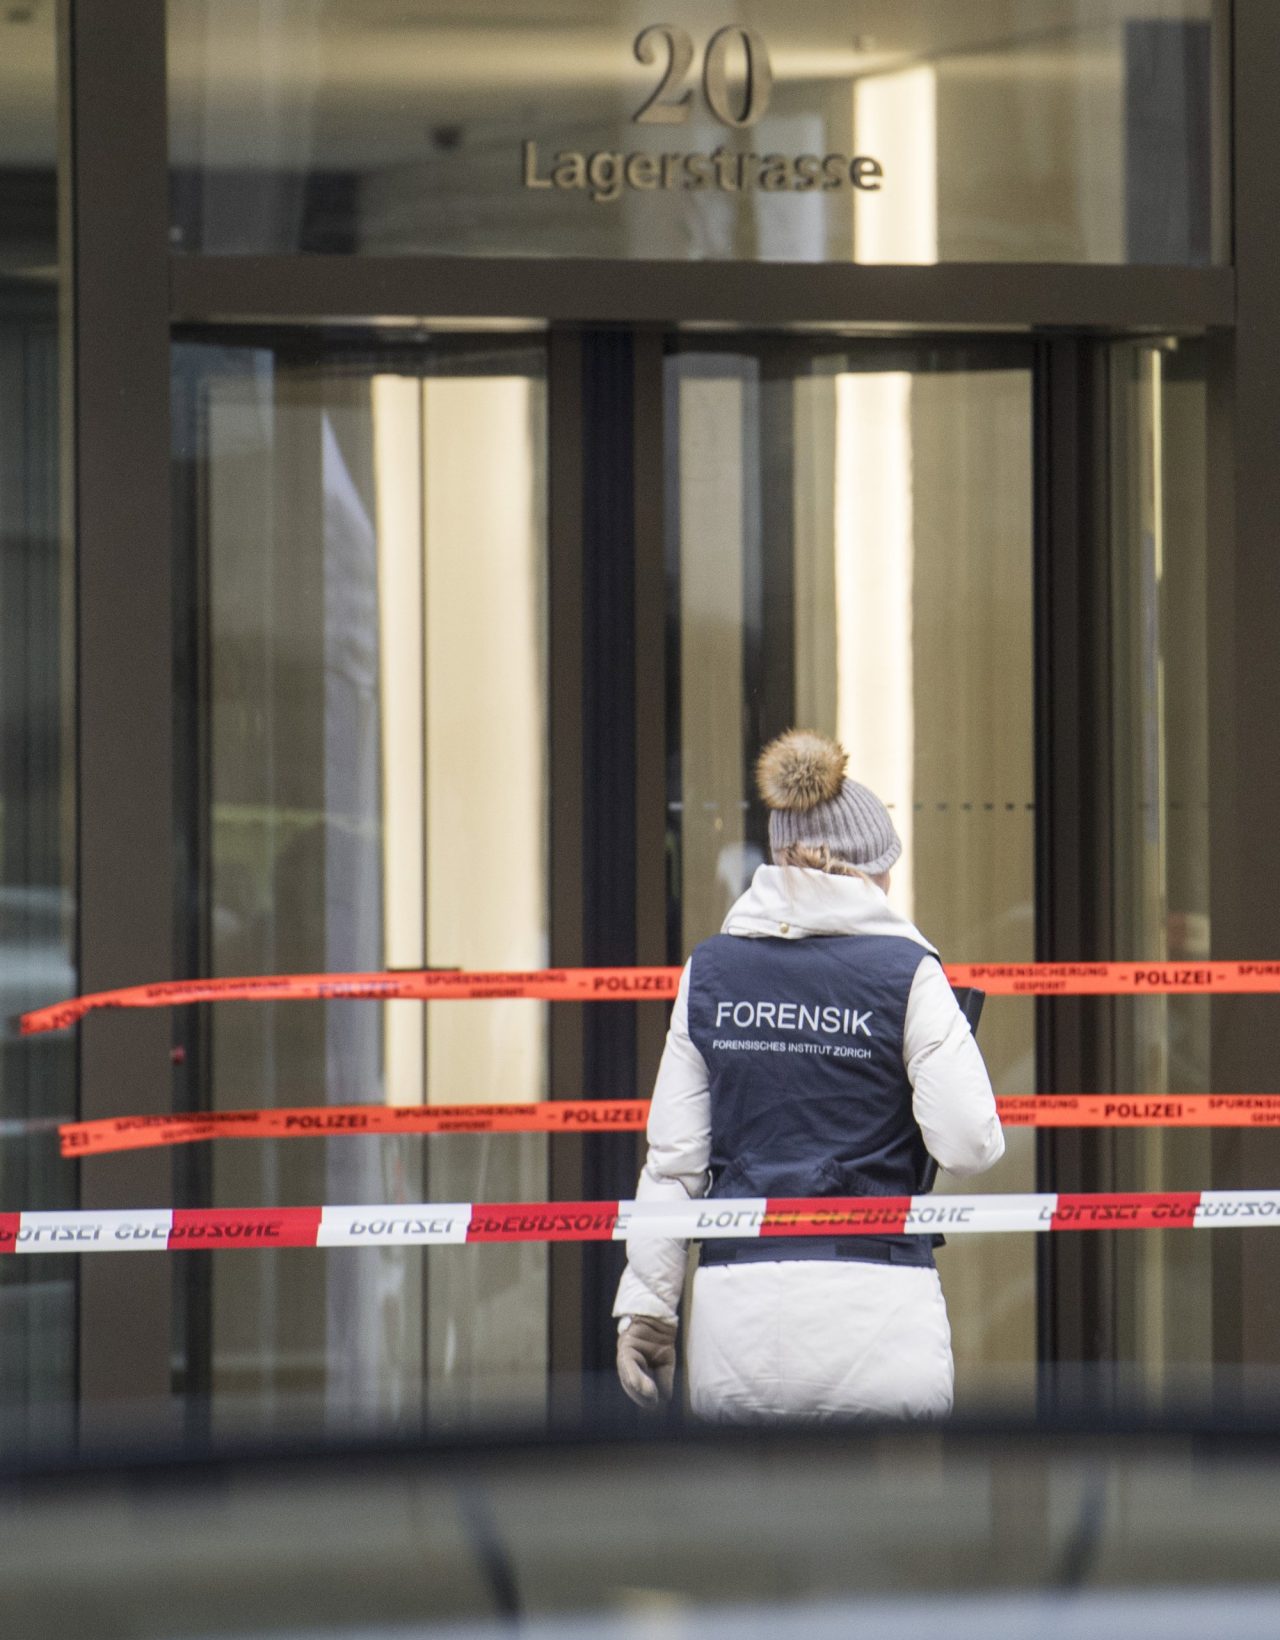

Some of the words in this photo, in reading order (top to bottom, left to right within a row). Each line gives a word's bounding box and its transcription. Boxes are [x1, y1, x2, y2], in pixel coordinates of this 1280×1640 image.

[632, 22, 773, 128] 20
[523, 139, 884, 201] Lagerstrasse
[594, 976, 673, 991] POLIZEI
[970, 966, 1108, 978] SPURENSICHERUNG
[1134, 970, 1212, 985] POLIZEI
[1013, 981, 1066, 991] GESPERRT
[715, 1001, 873, 1037] FORENSIK
[713, 1039, 786, 1052] FORENSISCHES
[788, 1043, 832, 1055] INSTITUT
[833, 1045, 872, 1059] ZÜRICH
[562, 1107, 643, 1122] POLIZEI
[1104, 1103, 1182, 1118] POLIZEI
[285, 1114, 368, 1128] POLIZEI
